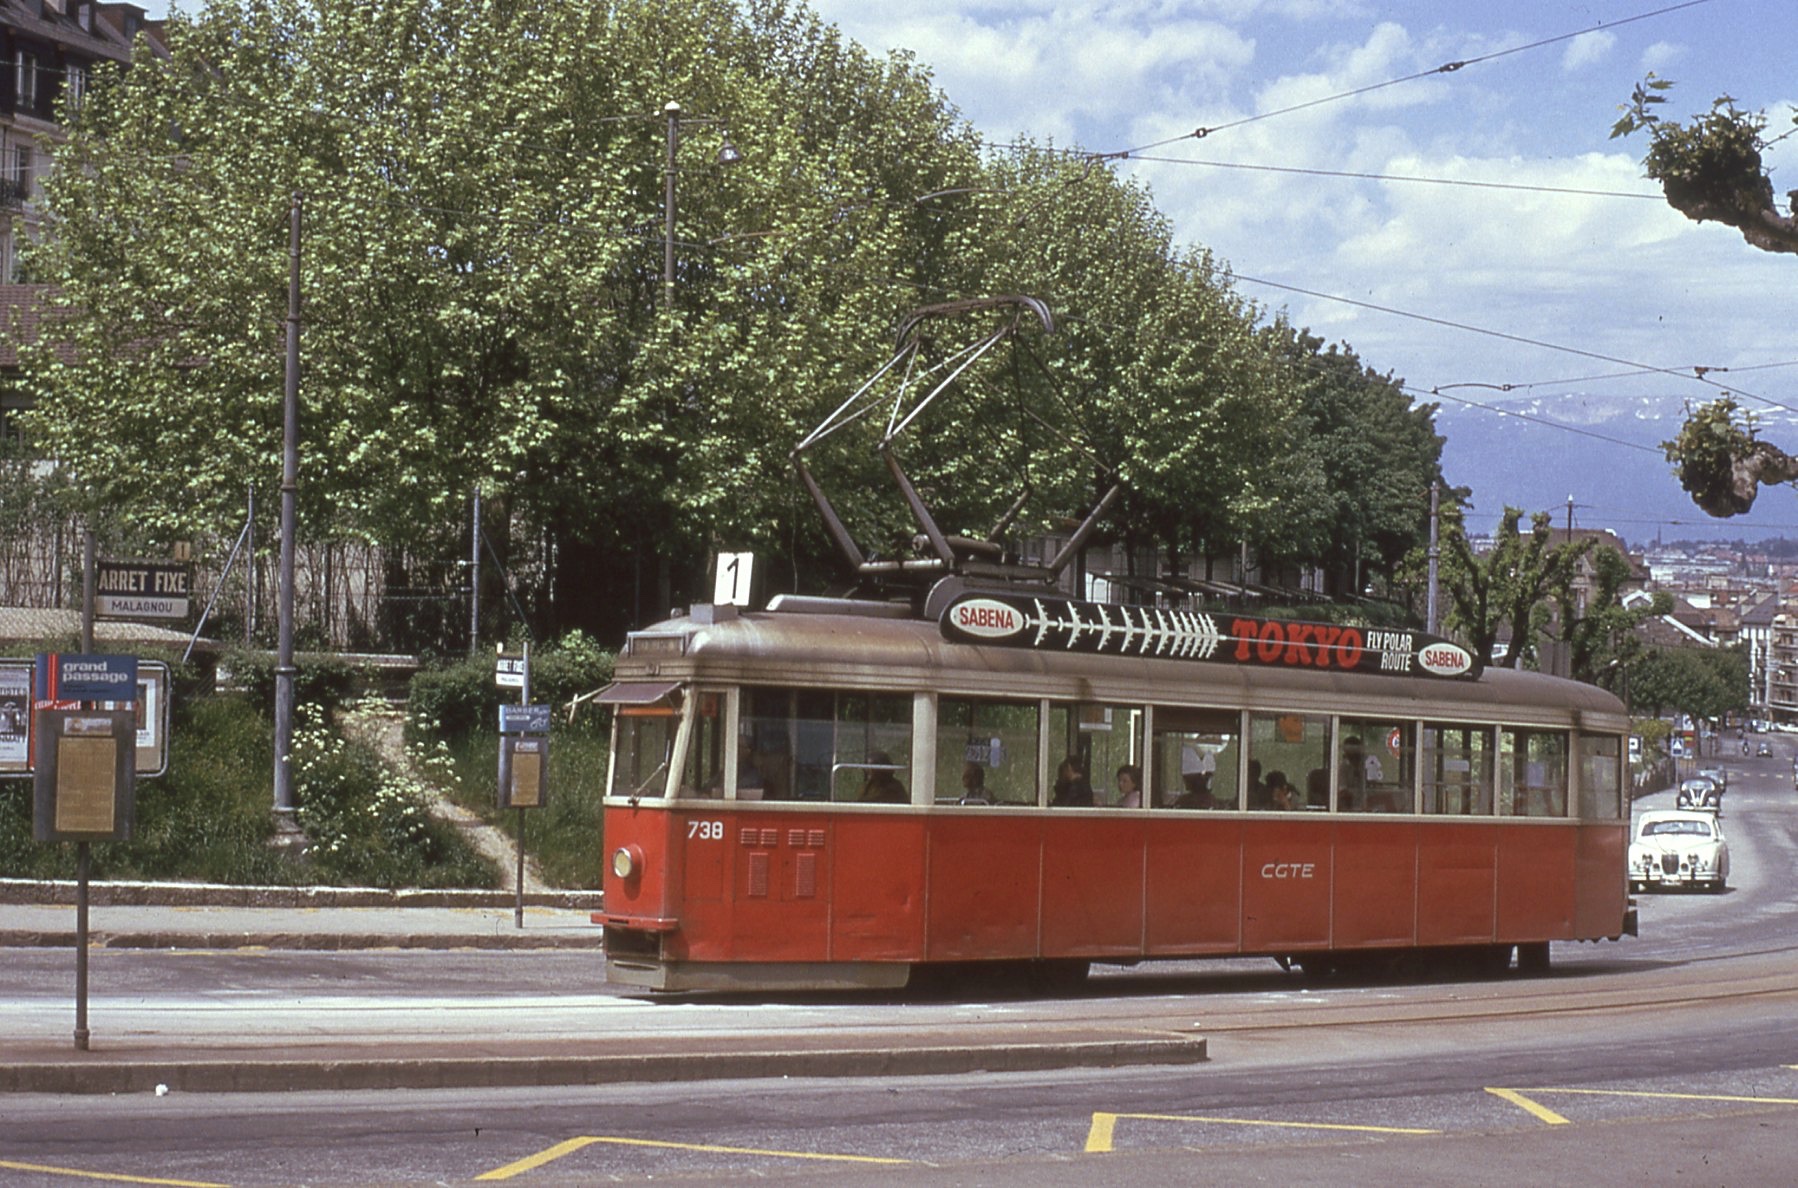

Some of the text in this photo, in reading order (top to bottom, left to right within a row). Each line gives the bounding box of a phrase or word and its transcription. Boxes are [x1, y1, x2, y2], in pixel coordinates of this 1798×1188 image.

[99, 570, 187, 593] ARRET FIXE
[727, 557, 739, 599] 1
[111, 600, 173, 612] MALAGNOU
[959, 606, 1015, 629] SABENA
[1231, 618, 1363, 668] TOKYO
[1366, 631, 1413, 652] FLY POLAR
[63, 661, 107, 672] grand
[1381, 652, 1412, 672] ROUTE
[1425, 649, 1465, 669] SABENA
[688, 821, 724, 840] 738
[1261, 863, 1315, 878] CGTE
